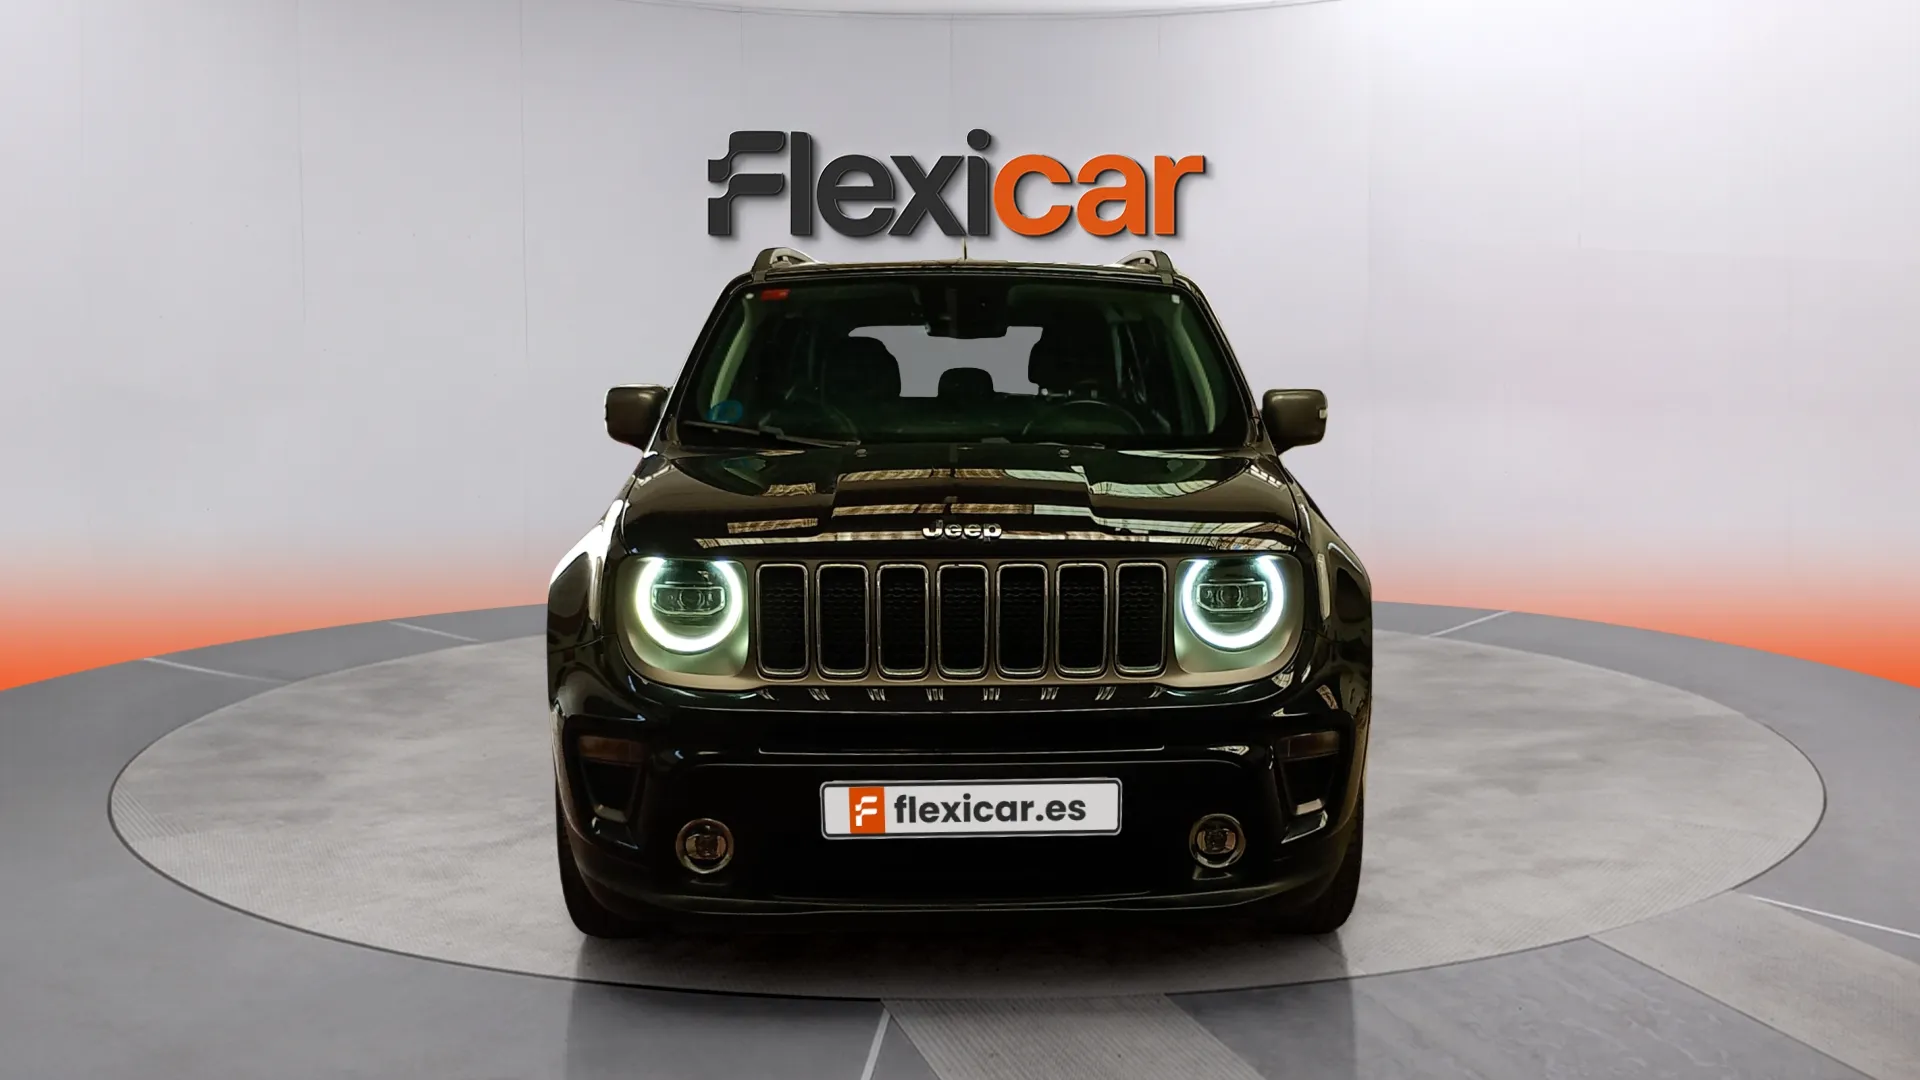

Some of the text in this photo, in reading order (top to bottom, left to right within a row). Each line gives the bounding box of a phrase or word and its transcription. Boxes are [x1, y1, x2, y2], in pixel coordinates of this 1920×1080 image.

[708, 129, 1204, 236] Flexicar
[922, 520, 1002, 542] Jeep
[894, 793, 1087, 823] flexicar.es
